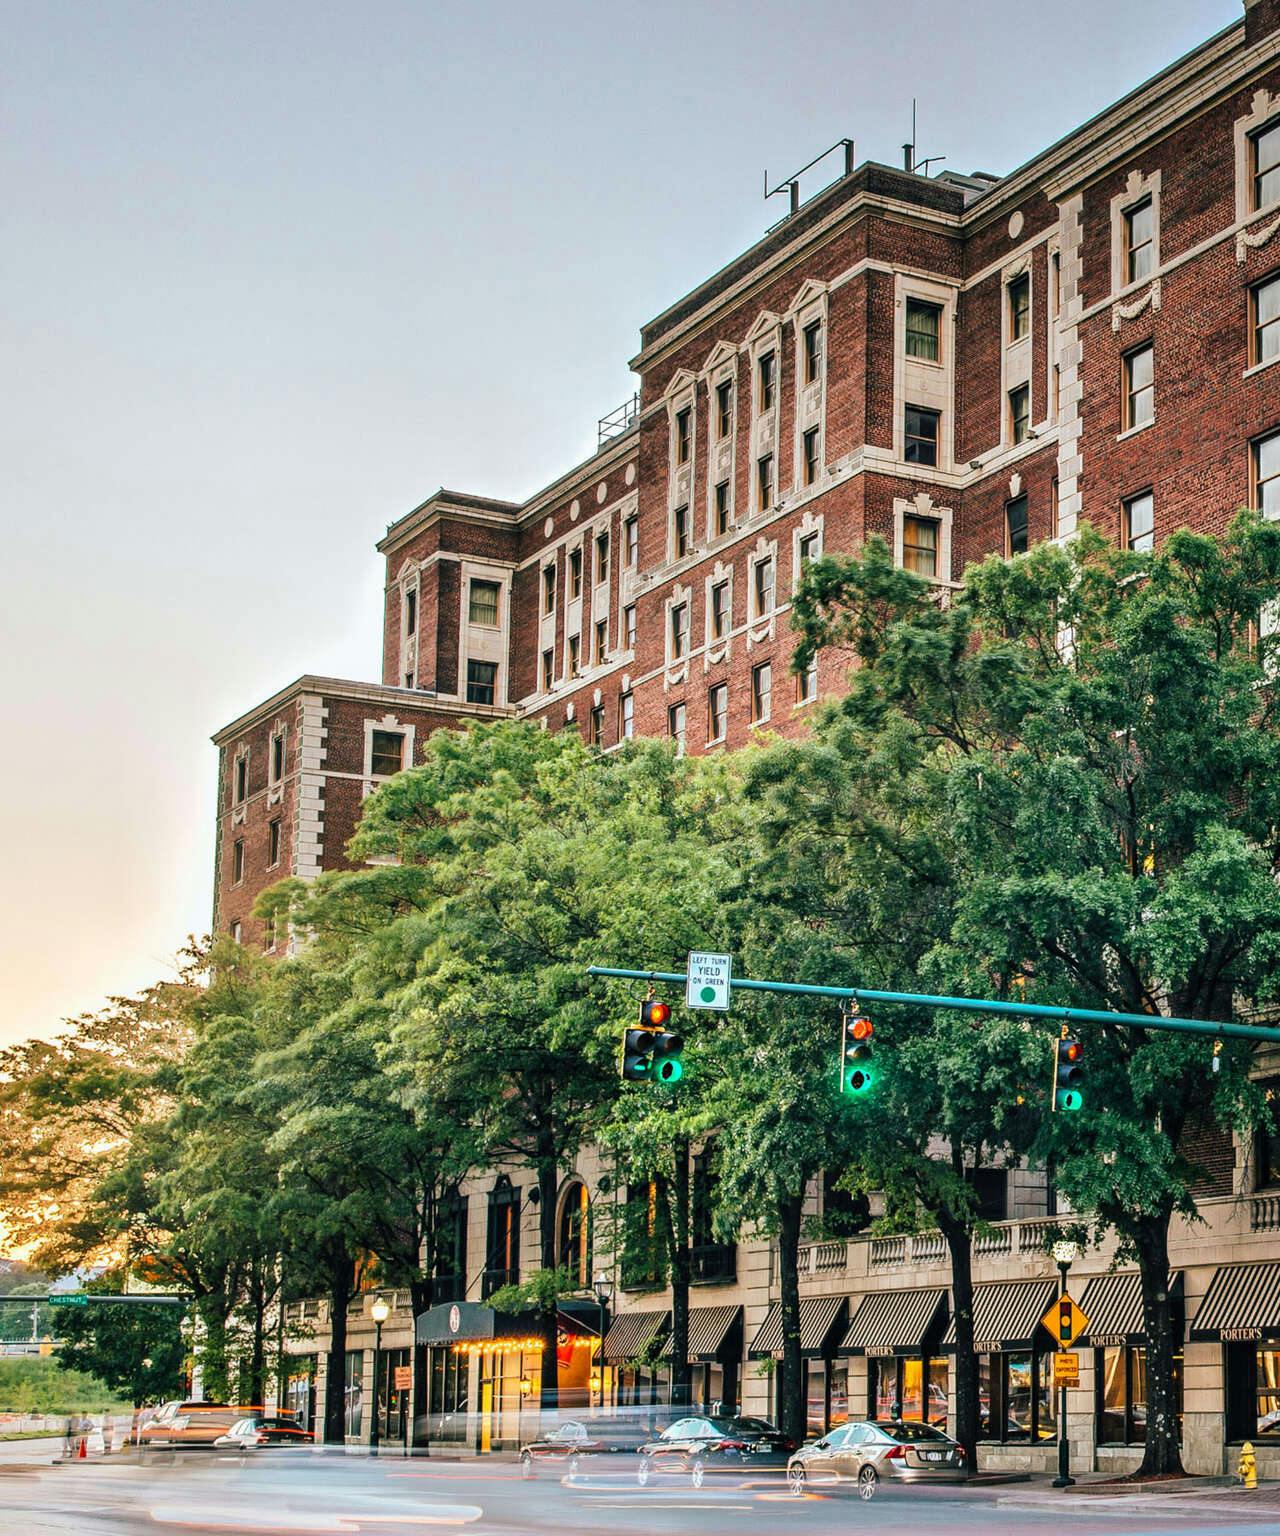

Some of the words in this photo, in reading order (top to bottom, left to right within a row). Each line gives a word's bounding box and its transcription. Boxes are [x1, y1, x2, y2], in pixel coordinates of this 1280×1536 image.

[692, 956, 707, 964] LEFT
[711, 957, 727, 965] TURN
[698, 966, 720, 976] YIELD
[692, 976, 702, 984] ON
[1220, 1328, 1262, 1340] PORTER'S
[1090, 1335, 1127, 1346] PORTER'S
[973, 1341, 1002, 1352] ORTER'S
